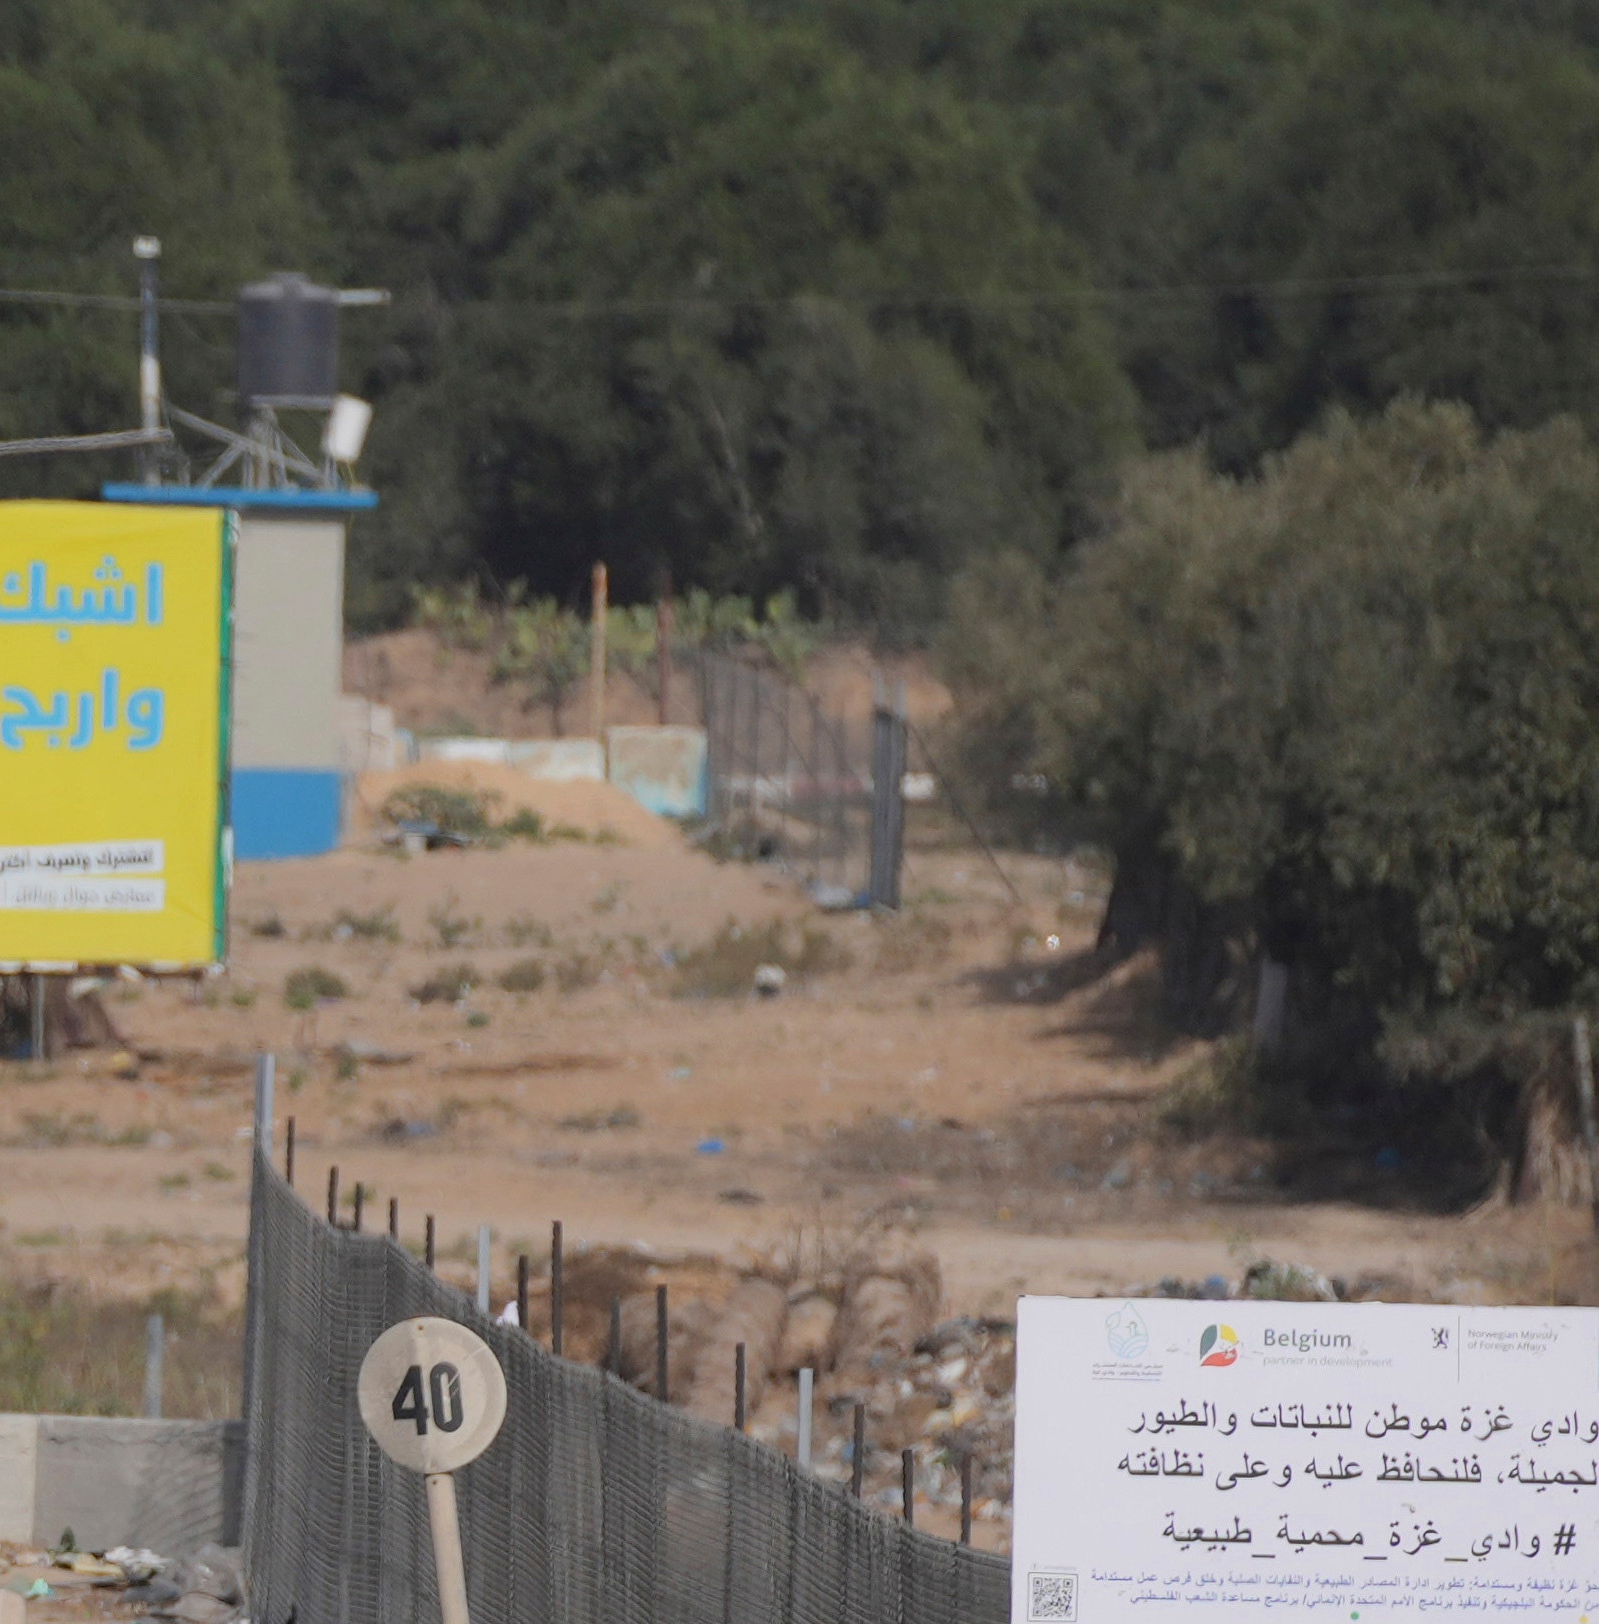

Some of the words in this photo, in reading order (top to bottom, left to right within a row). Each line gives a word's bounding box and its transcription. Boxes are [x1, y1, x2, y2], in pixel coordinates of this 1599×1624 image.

[1263, 1329, 1353, 1352] Belgium
[392, 1361, 464, 1436] 40
[1127, 1398, 1238, 1436] والطيور
[1250, 1402, 1352, 1438] للنباتات
[1365, 1403, 1447, 1439] موطن
[1460, 1405, 1514, 1441] غزة
[1530, 1410, 1599, 1447] وادي
[1117, 1447, 1204, 1477] نظافته
[1215, 1453, 1292, 1491] وعلى
[1304, 1453, 1363, 1489] عليه
[1376, 1451, 1482, 1483] فلنحافظ
